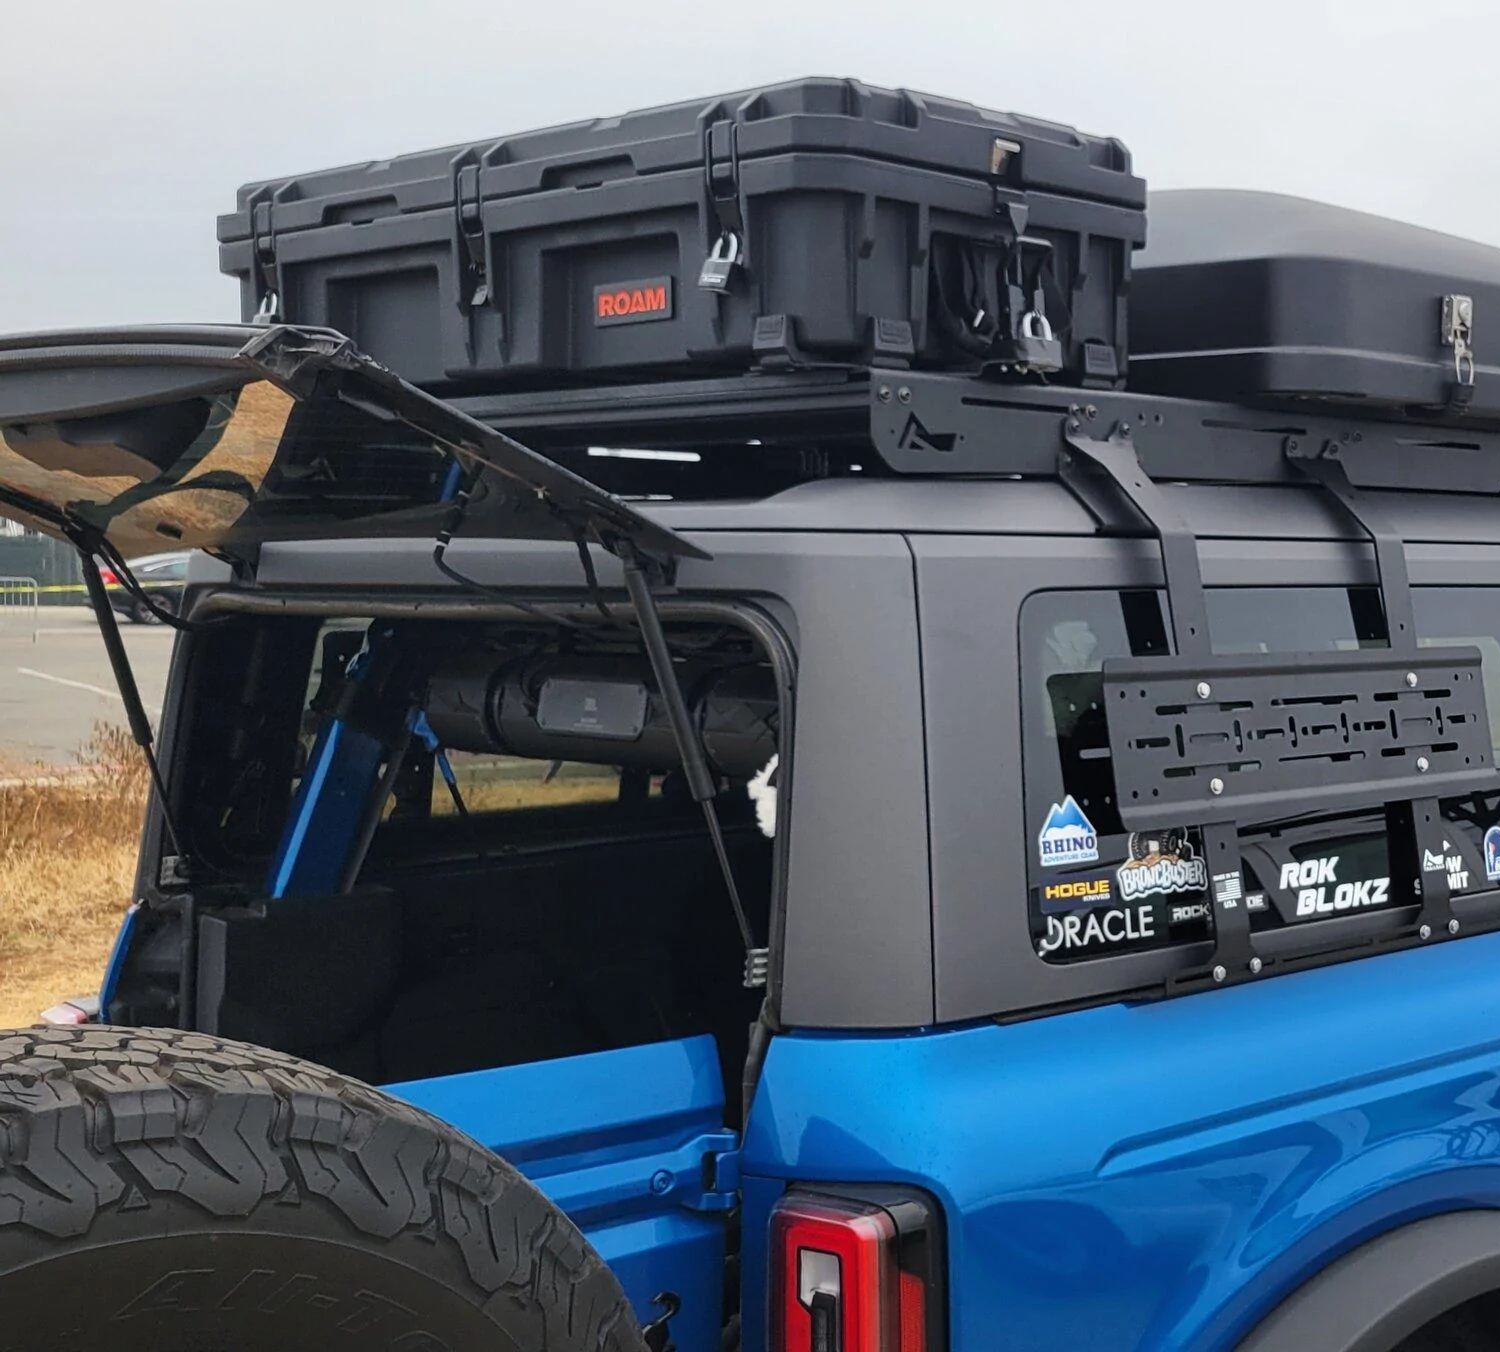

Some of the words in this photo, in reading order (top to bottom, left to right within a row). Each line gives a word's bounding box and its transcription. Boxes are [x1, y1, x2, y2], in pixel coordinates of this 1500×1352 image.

[598, 286, 666, 317] ROAM
[1042, 836, 1095, 854] RHINO
[1279, 856, 1340, 889] ROK
[1045, 879, 1110, 899] HOGUE
[1296, 877, 1390, 916] BLOKZ
[1223, 899, 1238, 909] USA
